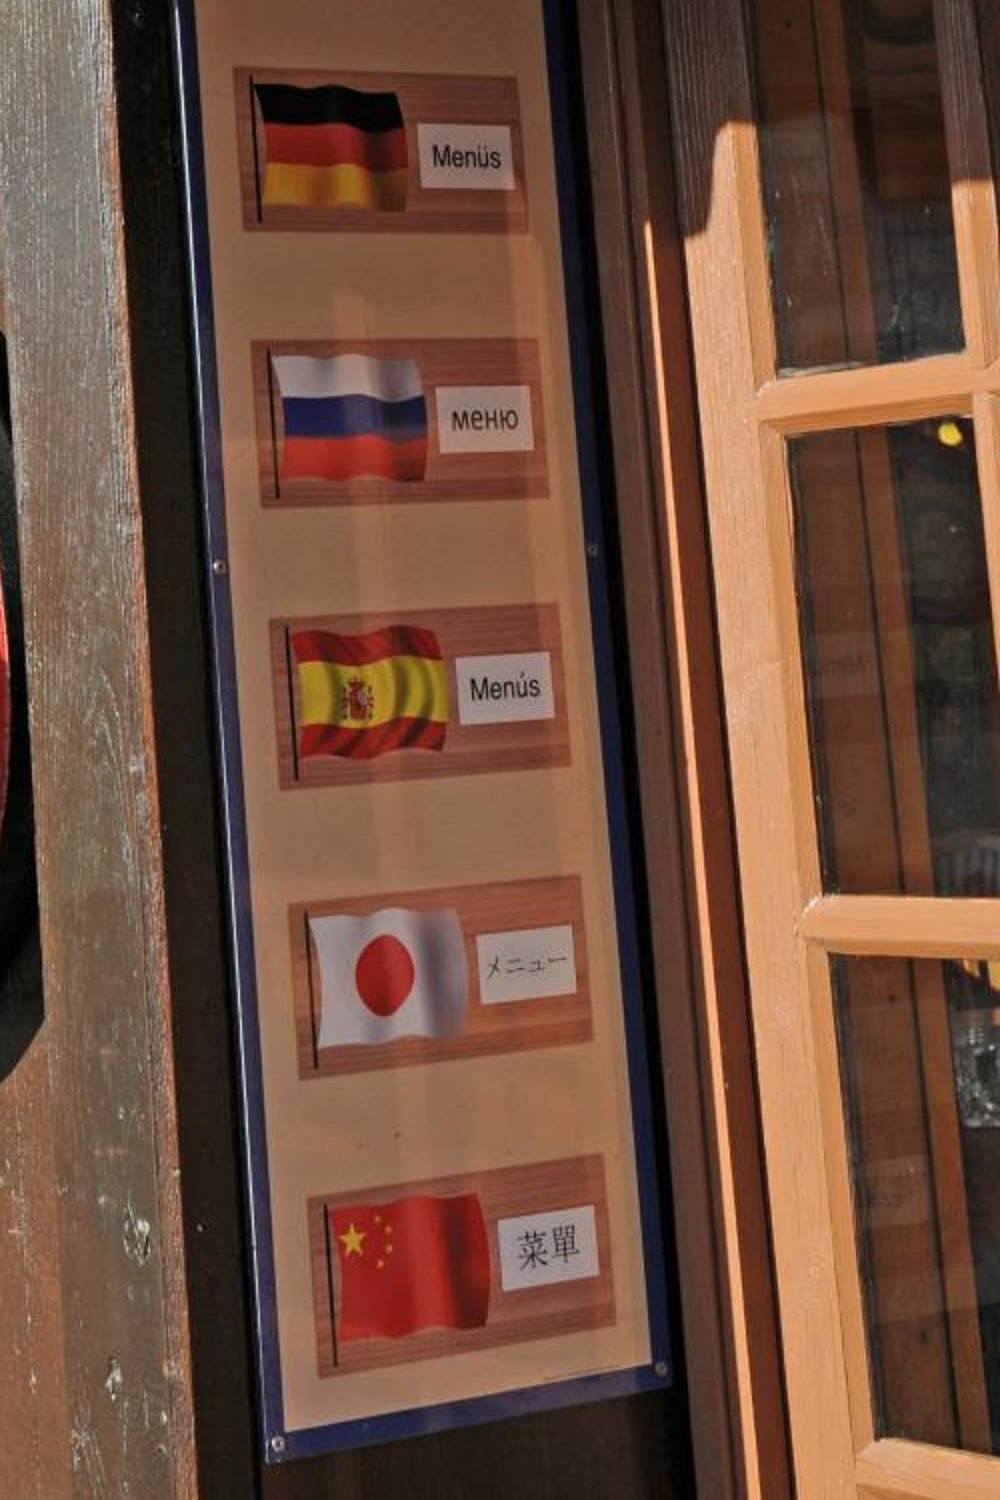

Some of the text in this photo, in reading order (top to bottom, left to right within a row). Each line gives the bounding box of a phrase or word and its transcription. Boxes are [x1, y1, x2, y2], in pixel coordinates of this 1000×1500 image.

[431, 144, 501, 169] Menüs
[470, 671, 541, 701] Menús
[486, 954, 567, 980] メニュー
[516, 1223, 580, 1271] 菜單
